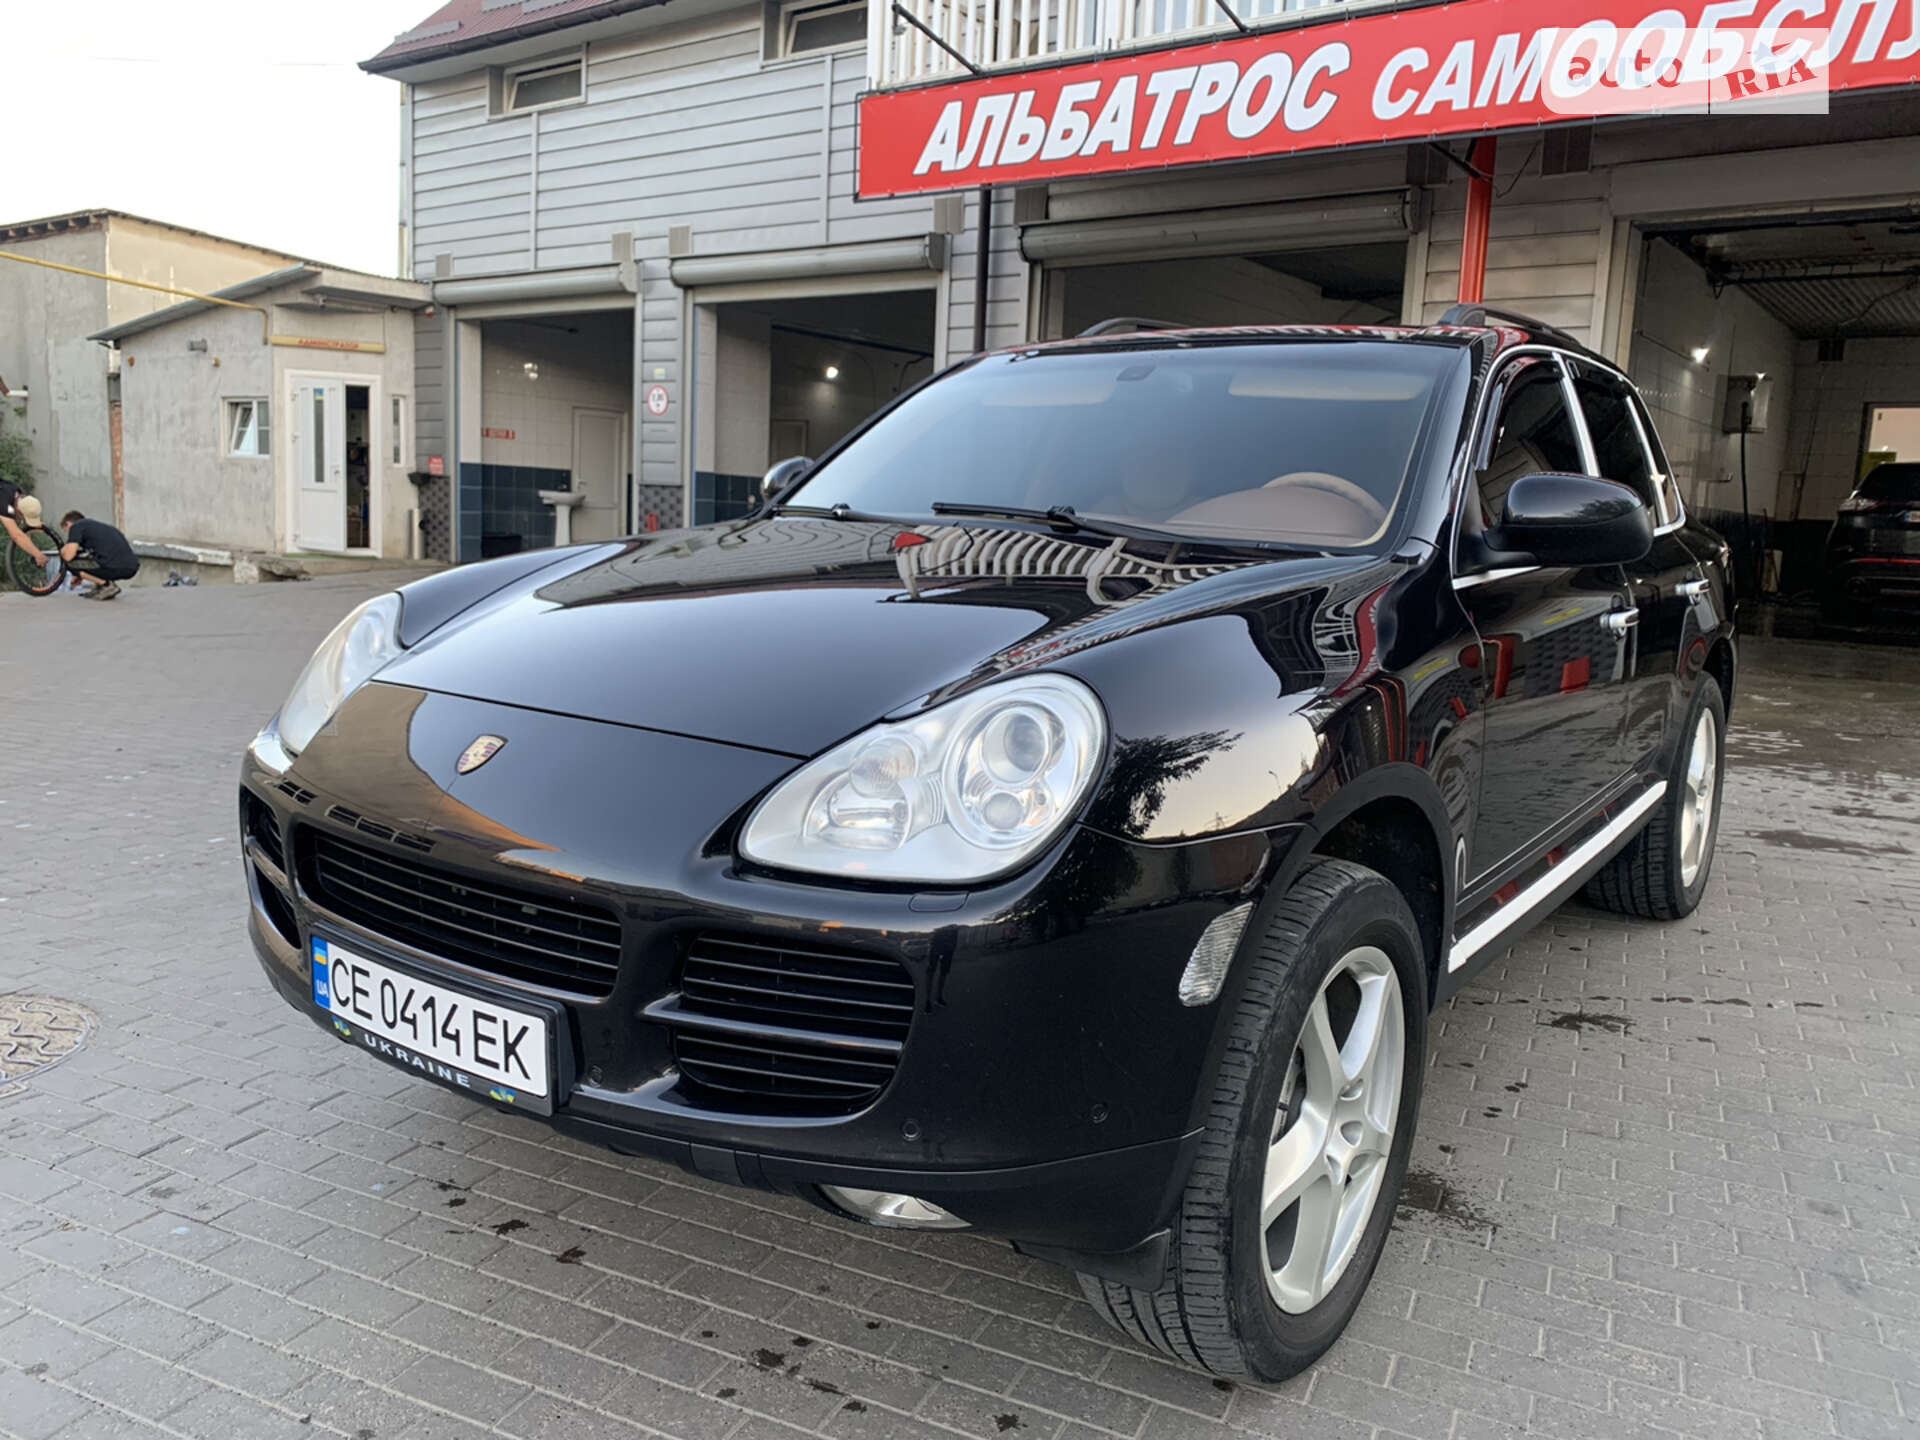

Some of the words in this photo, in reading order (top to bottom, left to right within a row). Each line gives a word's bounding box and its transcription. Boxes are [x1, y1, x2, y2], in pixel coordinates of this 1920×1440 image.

[912, 42, 1351, 175] АЛЬБАТРОС
[316, 978, 329, 998] UA
[330, 957, 373, 1021] CE
[379, 978, 461, 1057] 0414
[472, 1009, 531, 1081] EK
[364, 1033, 471, 1088] UKRAINE
